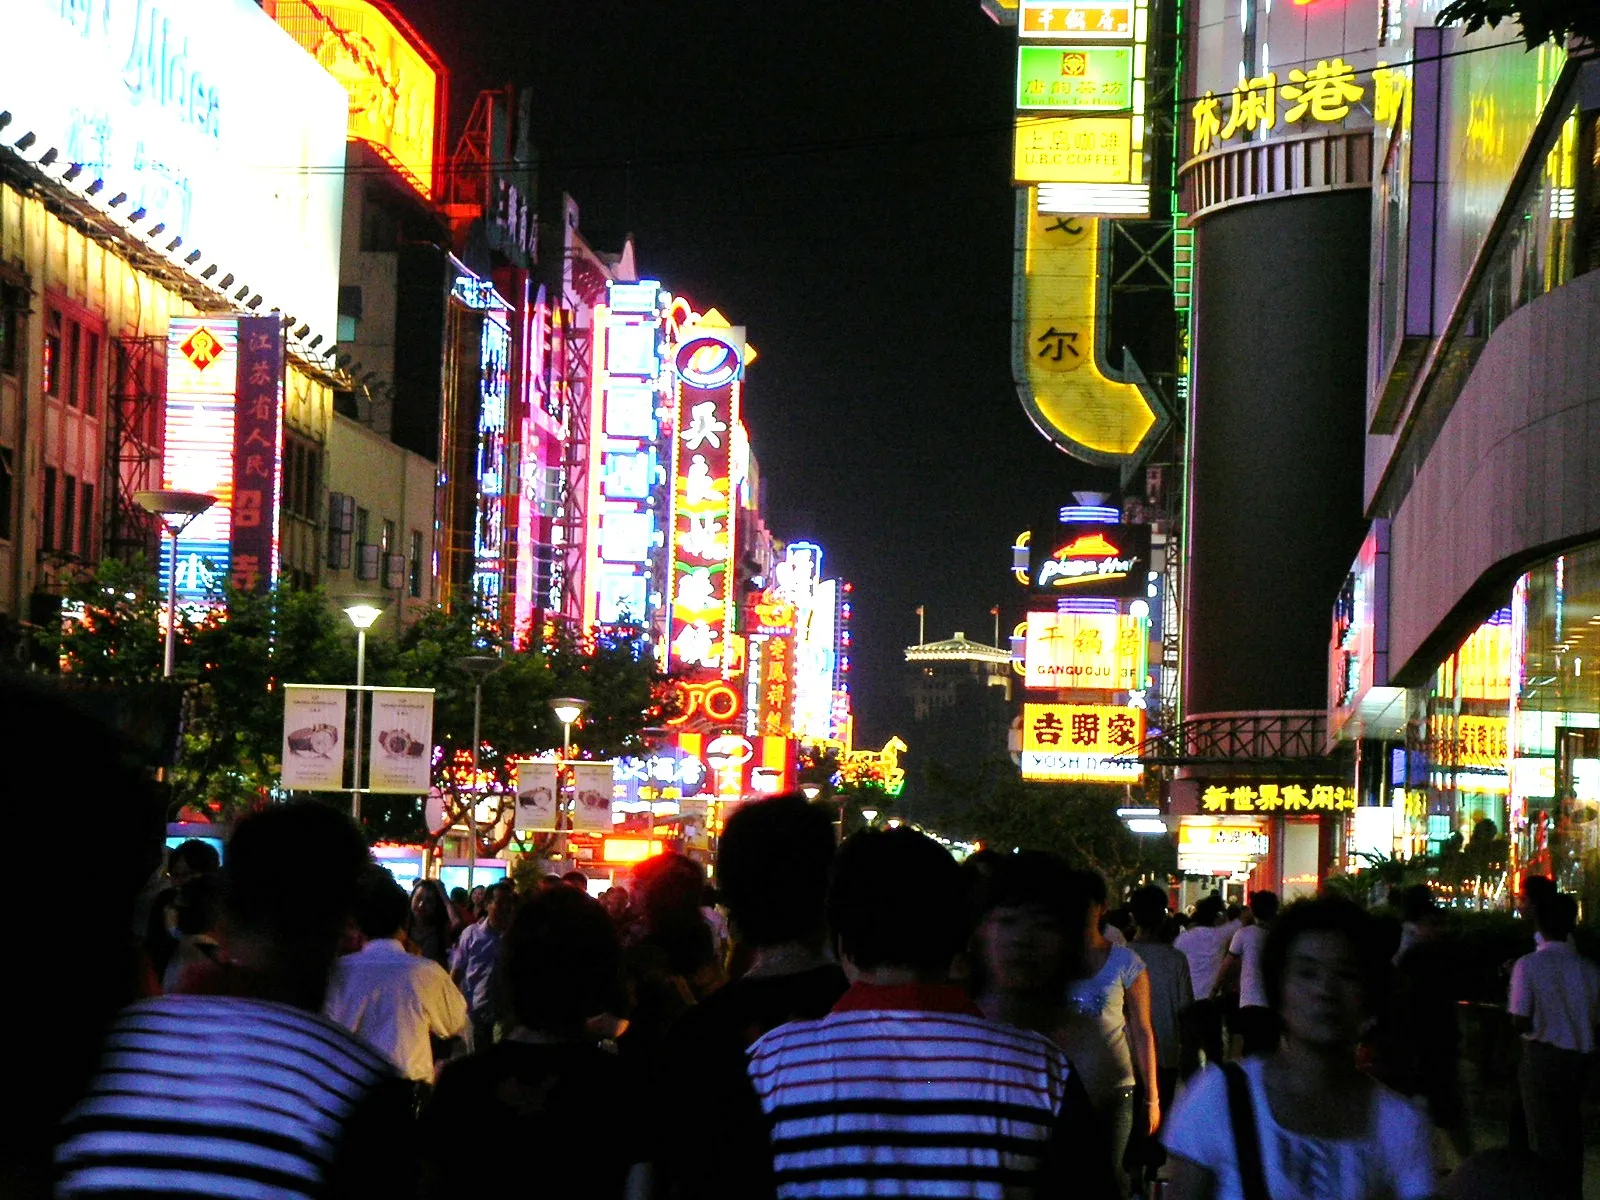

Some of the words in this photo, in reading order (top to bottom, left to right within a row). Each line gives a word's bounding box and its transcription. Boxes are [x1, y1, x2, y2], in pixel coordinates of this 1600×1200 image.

[1192, 58, 1365, 156] 休闲港
[1025, 130, 1121, 151] 上岛咖啡
[1066, 154, 1120, 167] COFFEE
[1037, 665, 1111, 676] GANGUOJU
[1120, 668, 1137, 678] 3F
[1034, 712, 1136, 746] 吉野家
